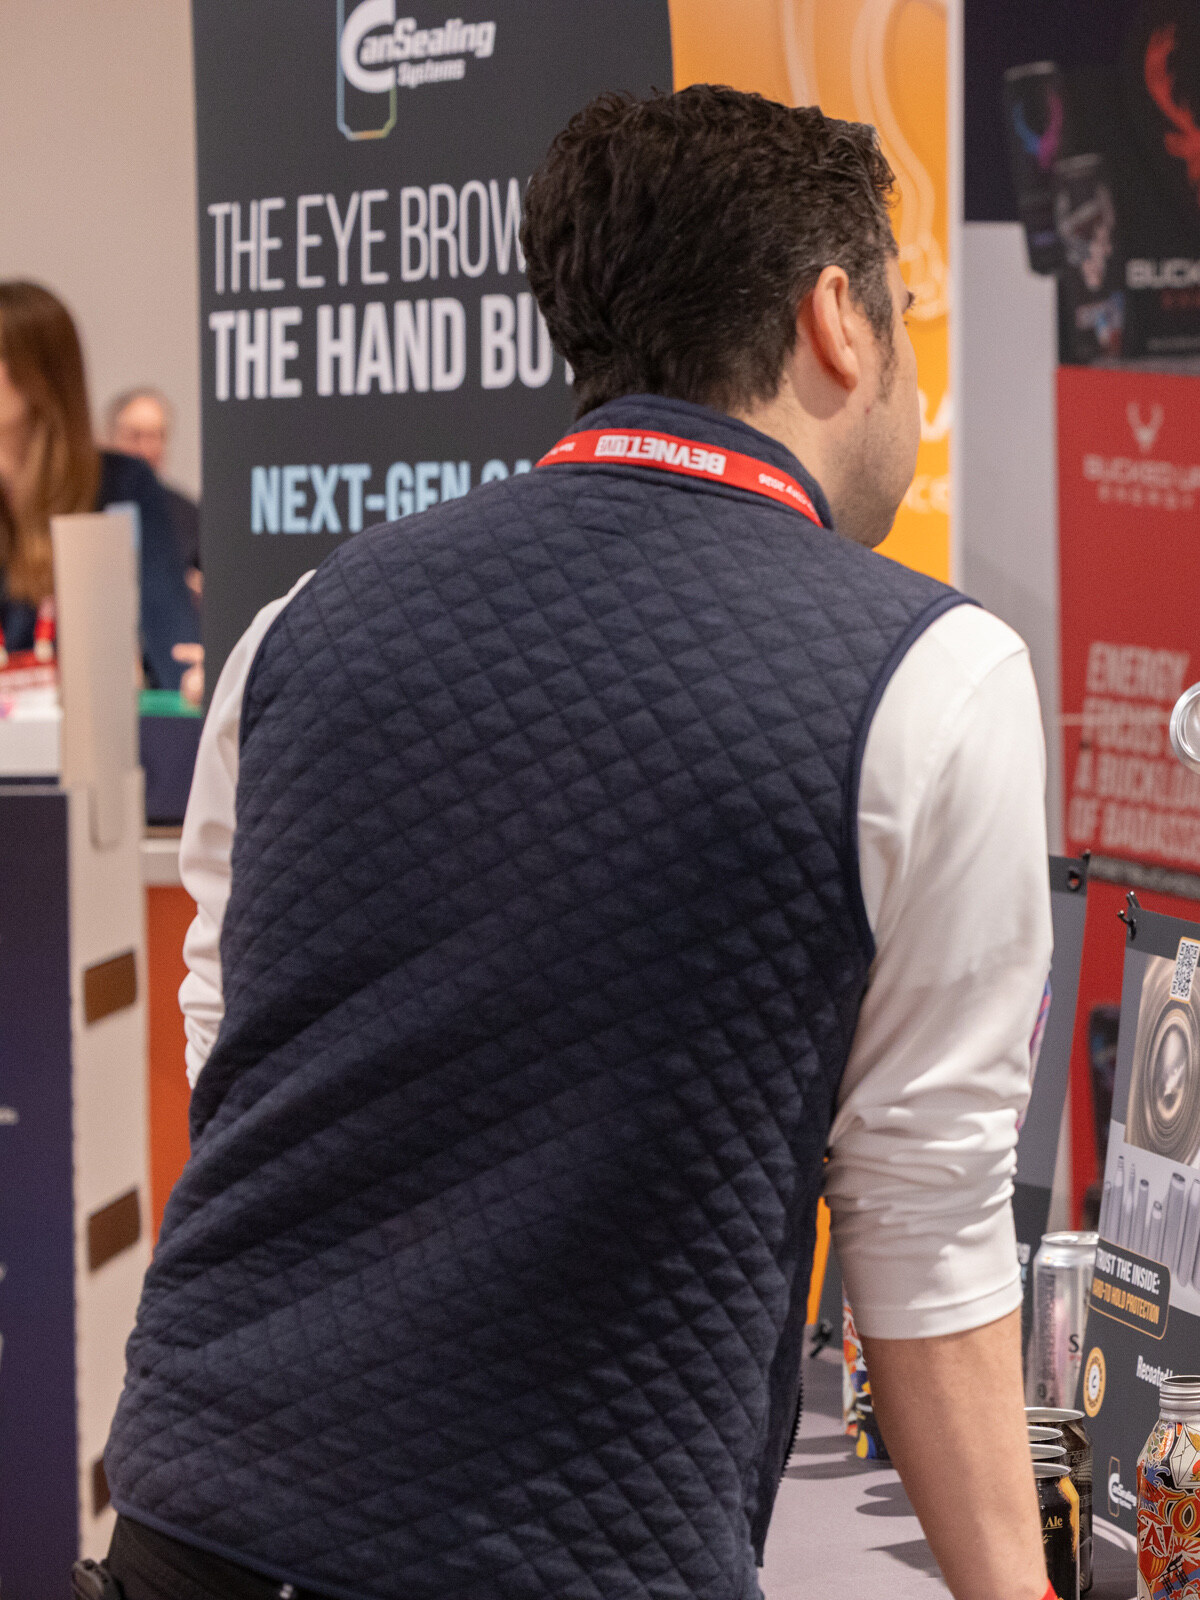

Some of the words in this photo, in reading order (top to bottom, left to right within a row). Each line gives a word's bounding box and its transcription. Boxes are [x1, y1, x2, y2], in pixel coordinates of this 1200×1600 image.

[397, 58, 466, 89] Systems
[207, 197, 286, 294] THE
[296, 189, 389, 289] EYE
[400, 178, 533, 283] BROW
[208, 306, 303, 401] THE
[316, 297, 467, 397] HAND
[480, 292, 576, 390] BU
[250, 461, 472, 535] NEXT-GEN
[1087, 642, 1190, 701] ENERGY
[1116, 1256, 1133, 1283] THE
[1045, 1515, 1063, 1528] Ale
